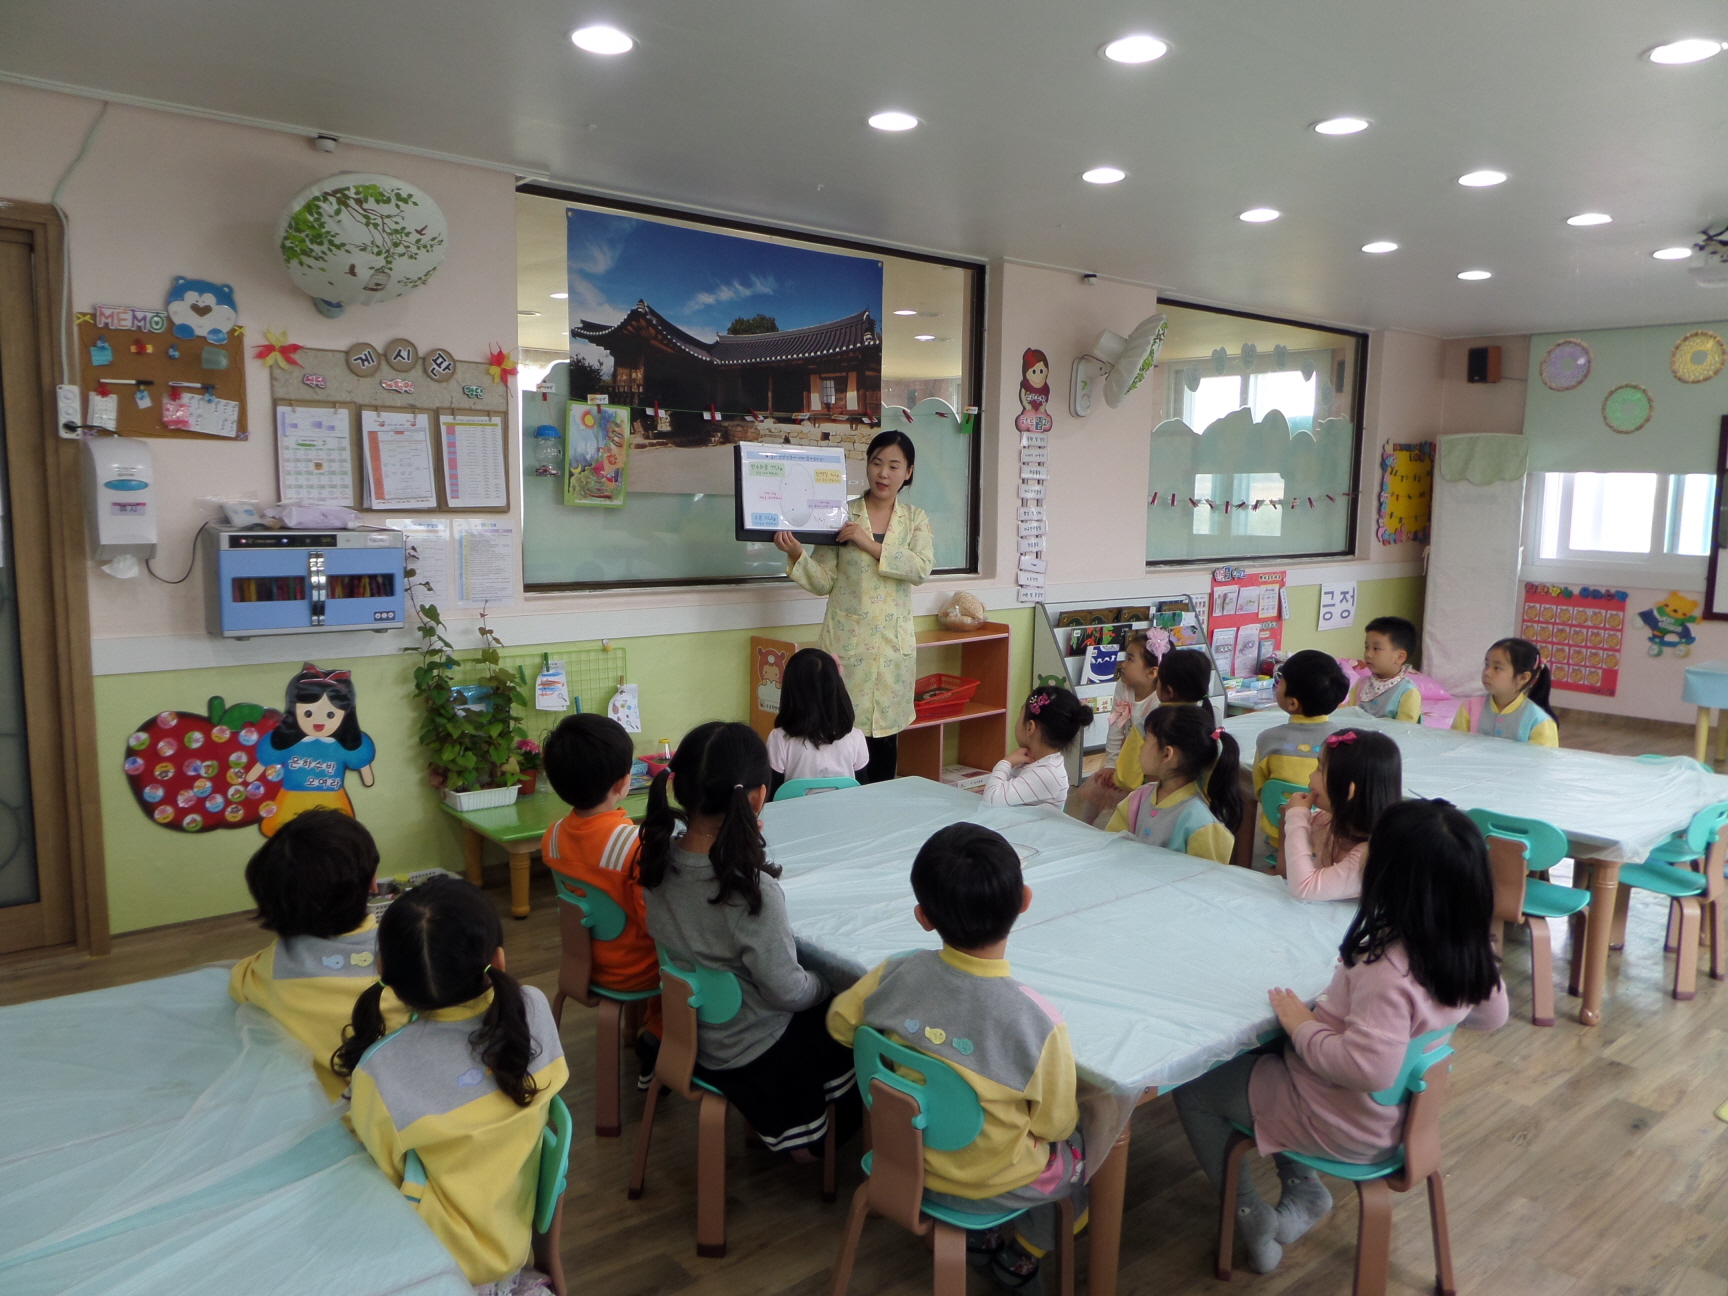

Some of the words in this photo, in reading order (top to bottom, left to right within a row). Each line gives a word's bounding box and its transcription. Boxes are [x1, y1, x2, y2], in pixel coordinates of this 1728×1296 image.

[97, 305, 166, 332] MEMO
[352, 348, 453, 379] 게시판
[303, 374, 326, 388] 식단
[381, 379, 415, 394] 계획안
[464, 385, 485, 398] 명단
[1020, 416, 1049, 430] 하루일과
[1525, 583, 1573, 599] 칭찬받는
[1322, 587, 1355, 621] 긍정
[289, 757, 336, 775] 은하수반
